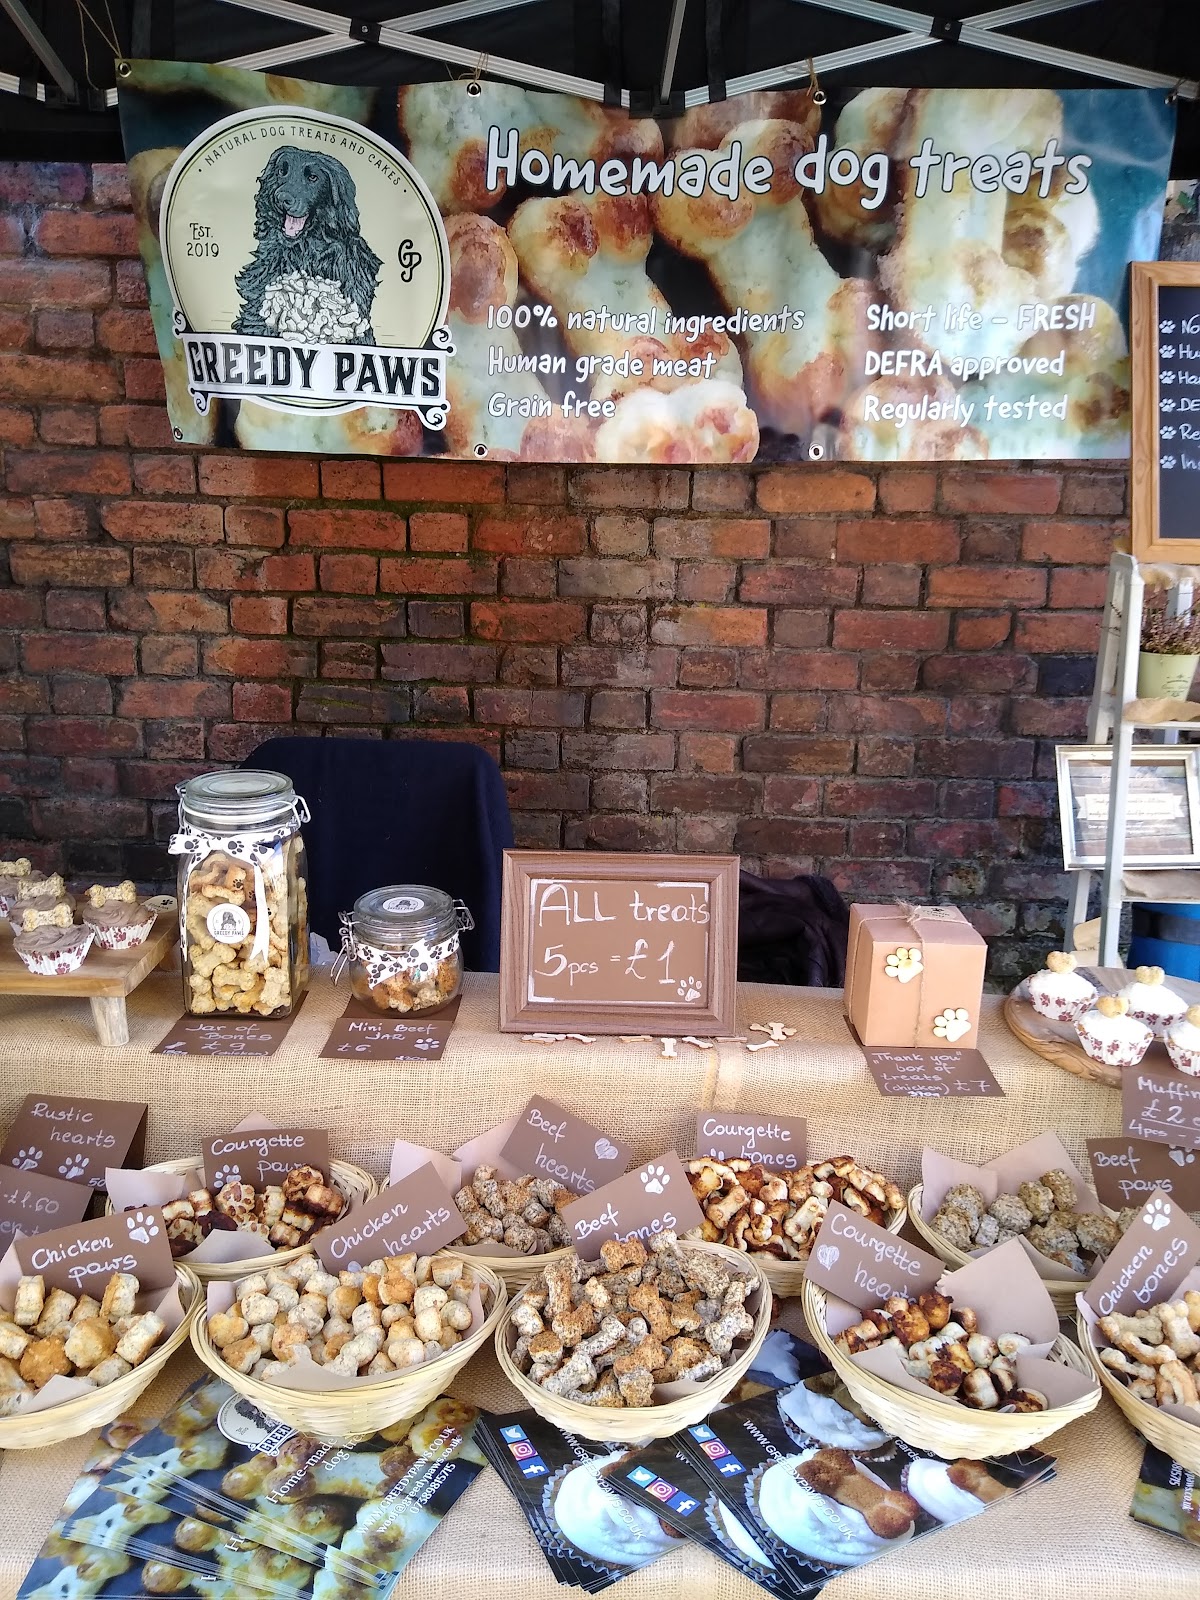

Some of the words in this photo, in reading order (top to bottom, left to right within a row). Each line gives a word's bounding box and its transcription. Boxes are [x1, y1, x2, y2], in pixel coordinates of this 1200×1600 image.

[205, 130, 257, 167] NATURAL
[260, 125, 286, 139] DOG
[290, 125, 337, 144] TREATS
[340, 138, 366, 157] AND
[367, 153, 402, 187] CAKES
[486, 125, 774, 201] Homemade
[794, 133, 889, 210] dog
[909, 138, 1093, 198] treats
[186, 241, 220, 258] 2019
[487, 305, 558, 329] 100%
[567, 305, 656, 334] natural
[664, 305, 806, 342] ingredients
[866, 303, 937, 332] Short
[943, 302, 984, 332] life
[1016, 302, 1097, 331] FRESH
[187, 340, 319, 389] GREEDY
[333, 351, 441, 397] PAWS
[488, 346, 566, 376] Human
[575, 351, 645, 383] grade
[652, 352, 717, 378] meat
[864, 350, 943, 376] DEFRA
[951, 350, 1066, 381] approved
[488, 392, 552, 418] Grain
[560, 390, 617, 418] free
[863, 395, 976, 428] Regularly
[983, 394, 1068, 422] tested
[539, 883, 617, 927] ALL
[629, 889, 711, 925] treats
[185, 1023, 227, 1032] Jar
[235, 1023, 260, 1035] of
[199, 1032, 273, 1041] Bones
[348, 1022, 383, 1033] Mini
[394, 1023, 438, 1035] Beef
[365, 1033, 406, 1041] JAR
[881, 1073, 943, 1081] treats
[896, 1064, 926, 1073] box
[934, 1062, 956, 1074] of
[884, 1082, 950, 1096] (chicken)
[31, 1102, 94, 1123] Rustic
[527, 1109, 567, 1143] Beef
[50, 1122, 117, 1149] hearts
[210, 1134, 305, 1157] Courgette
[703, 1118, 792, 1149] Courgette
[257, 1160, 308, 1182] paw
[535, 1142, 596, 1192] hearts
[1093, 1145, 1141, 1175] Beef
[1118, 1179, 1173, 1200] paws
[331, 1202, 409, 1259] Chicken
[383, 1207, 451, 1256] hearts
[575, 1202, 619, 1240] Beef
[31, 1236, 114, 1270] Chicken
[831, 1213, 921, 1276] Courgette
[68, 1253, 138, 1288] paws
[1098, 1245, 1153, 1316] Chicken
[1134, 1237, 1189, 1304] bones
[259, 1424, 293, 1452] GREED
[321, 1448, 350, 1471] dog
[342, 1433, 364, 1450] tre
[265, 1438, 338, 1504] Home-made
[376, 1434, 463, 1534] woof@greedypaws.co.uk
[409, 1462, 457, 1514] 07389815715
